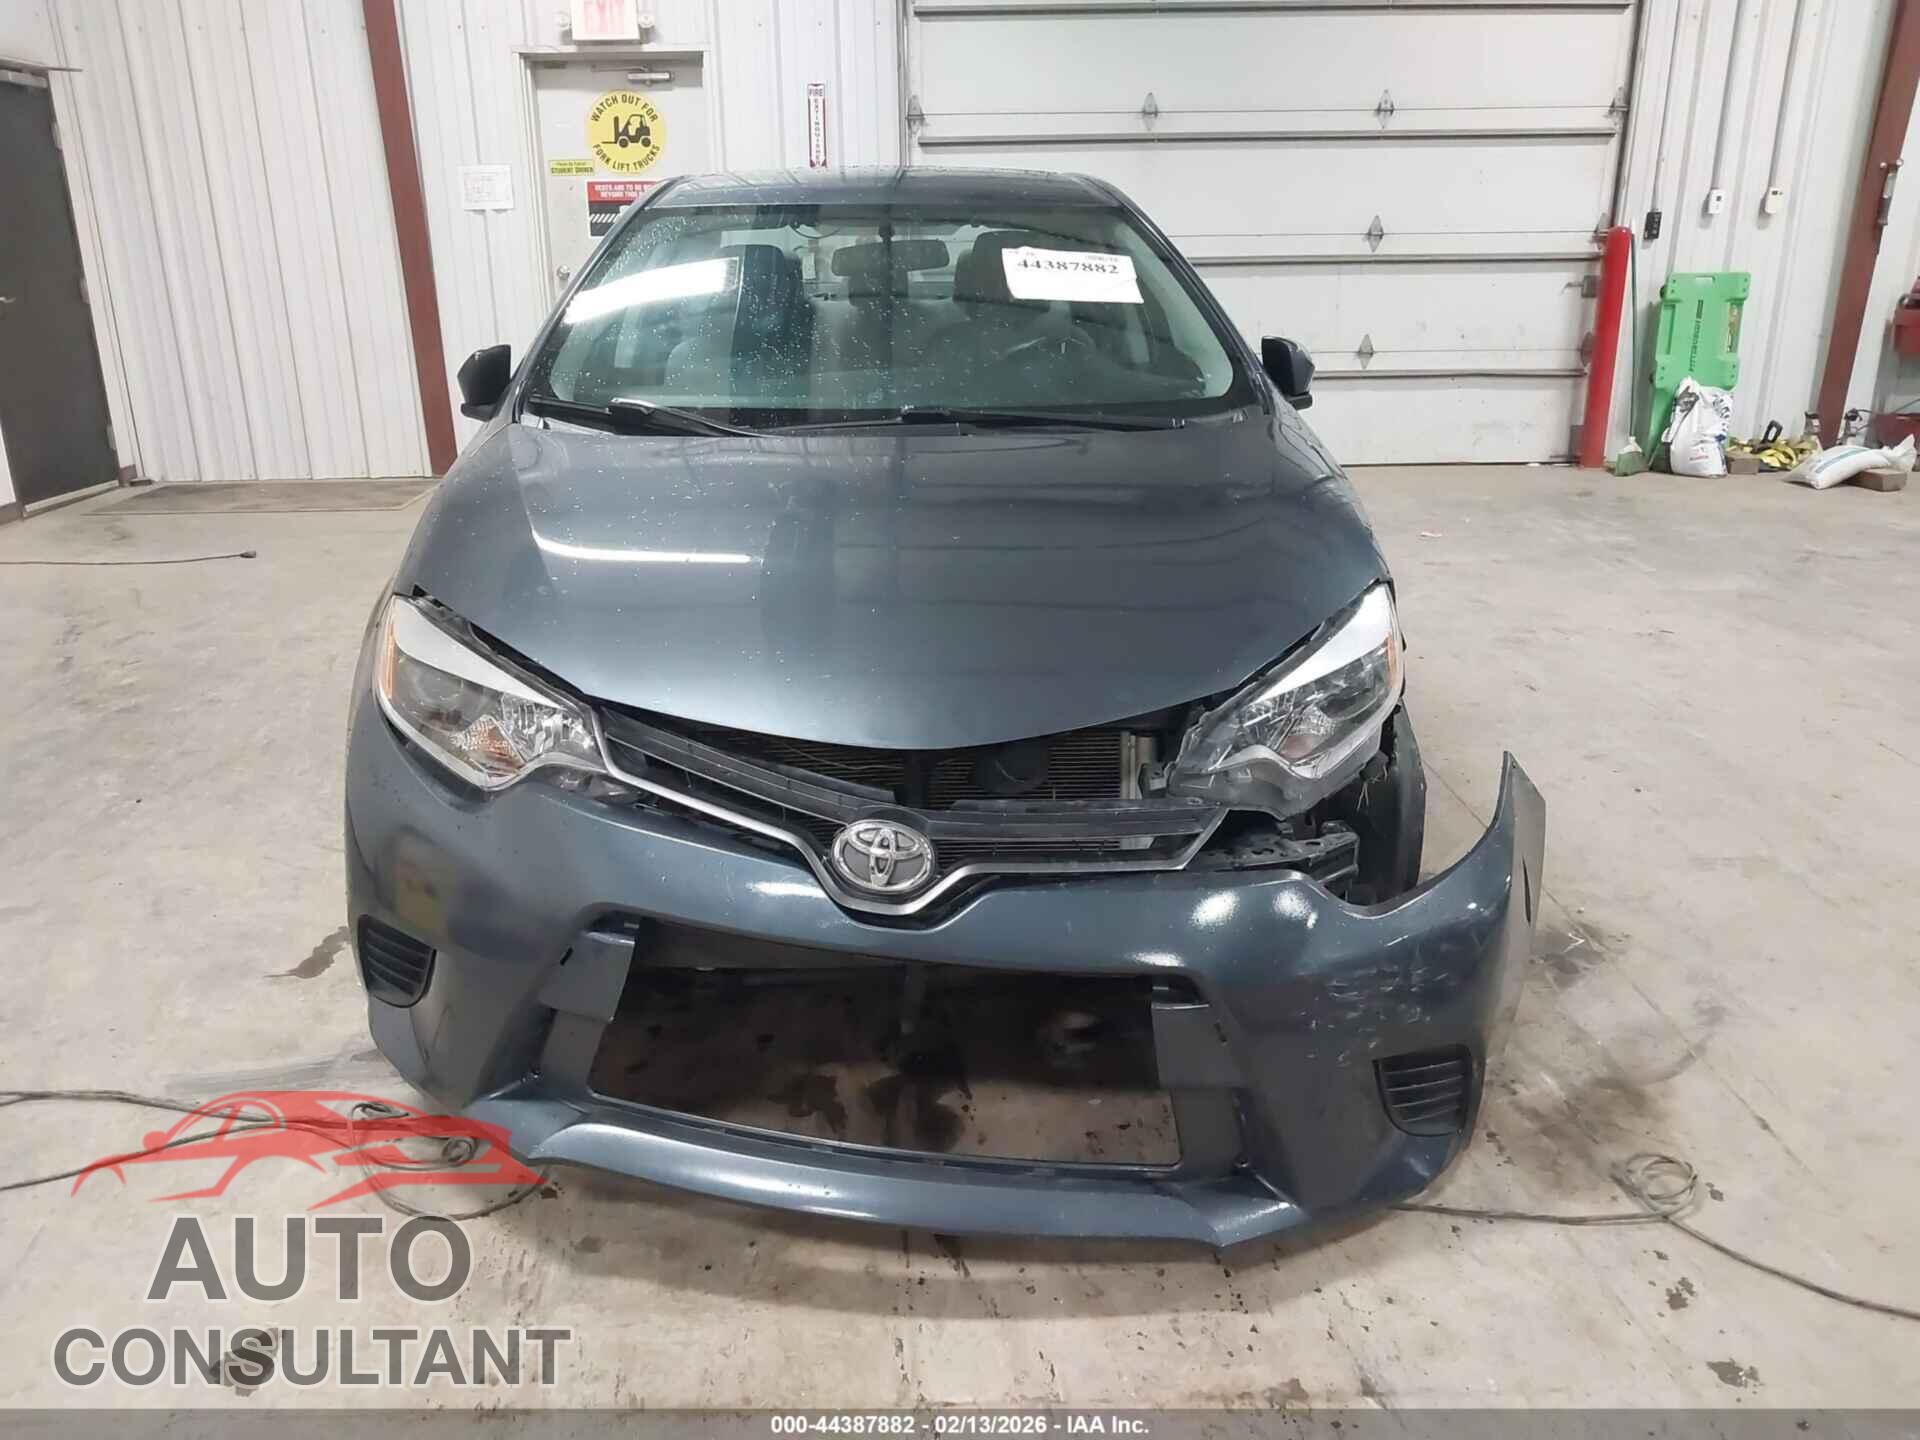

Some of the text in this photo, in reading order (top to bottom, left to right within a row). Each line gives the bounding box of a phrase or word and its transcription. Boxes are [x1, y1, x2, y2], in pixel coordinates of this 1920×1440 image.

[808, 88, 823, 97] FIRE
[591, 94, 659, 122] WATCH OUT FOR
[592, 144, 661, 172] FORK LIFT TRUCKS
[1018, 259, 1119, 274] 44387882
